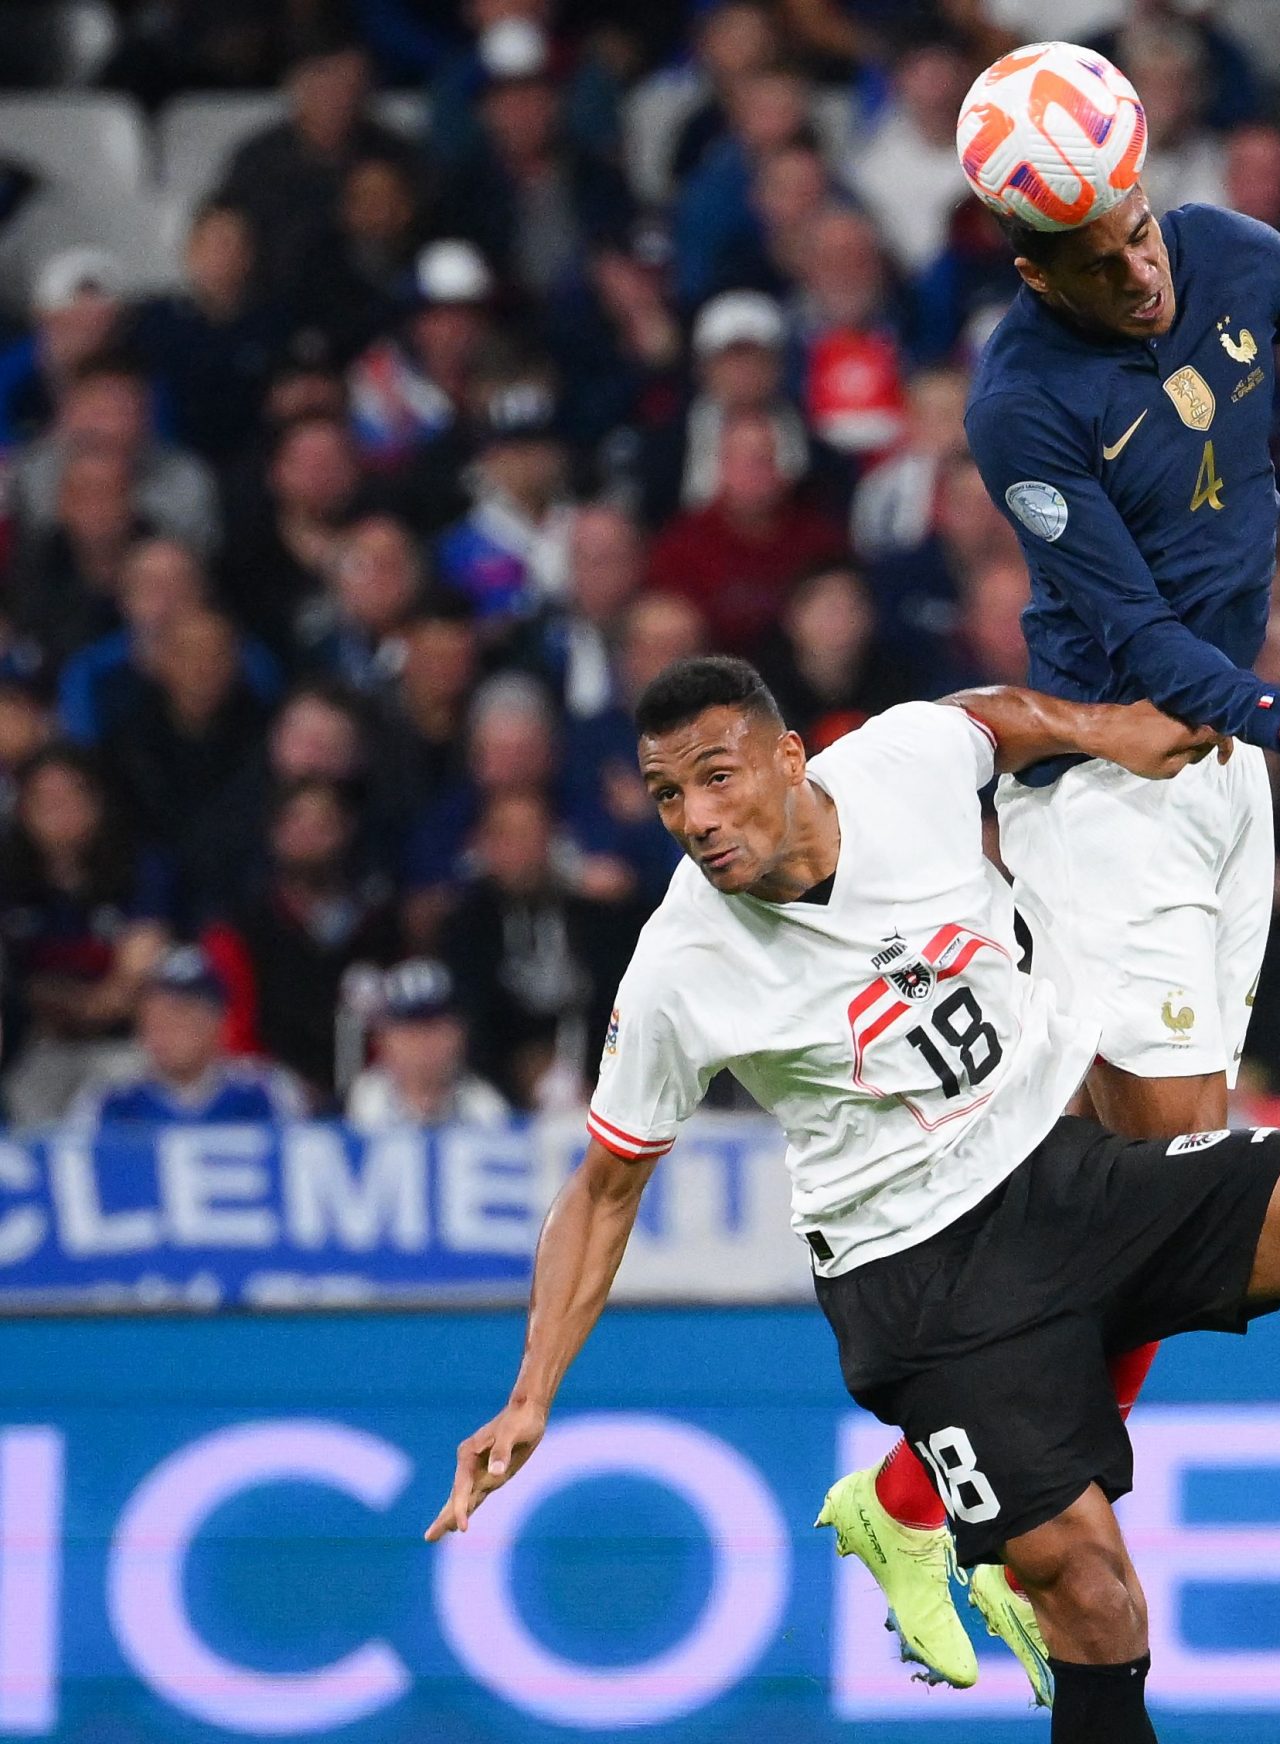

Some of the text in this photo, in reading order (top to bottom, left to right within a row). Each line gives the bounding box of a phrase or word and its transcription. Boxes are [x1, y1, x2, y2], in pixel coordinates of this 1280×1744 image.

[1188, 440, 1227, 512] 4
[870, 941, 908, 970] PUMA
[905, 986, 1003, 1099] 18
[858, 1508, 888, 1565] ULTRA
